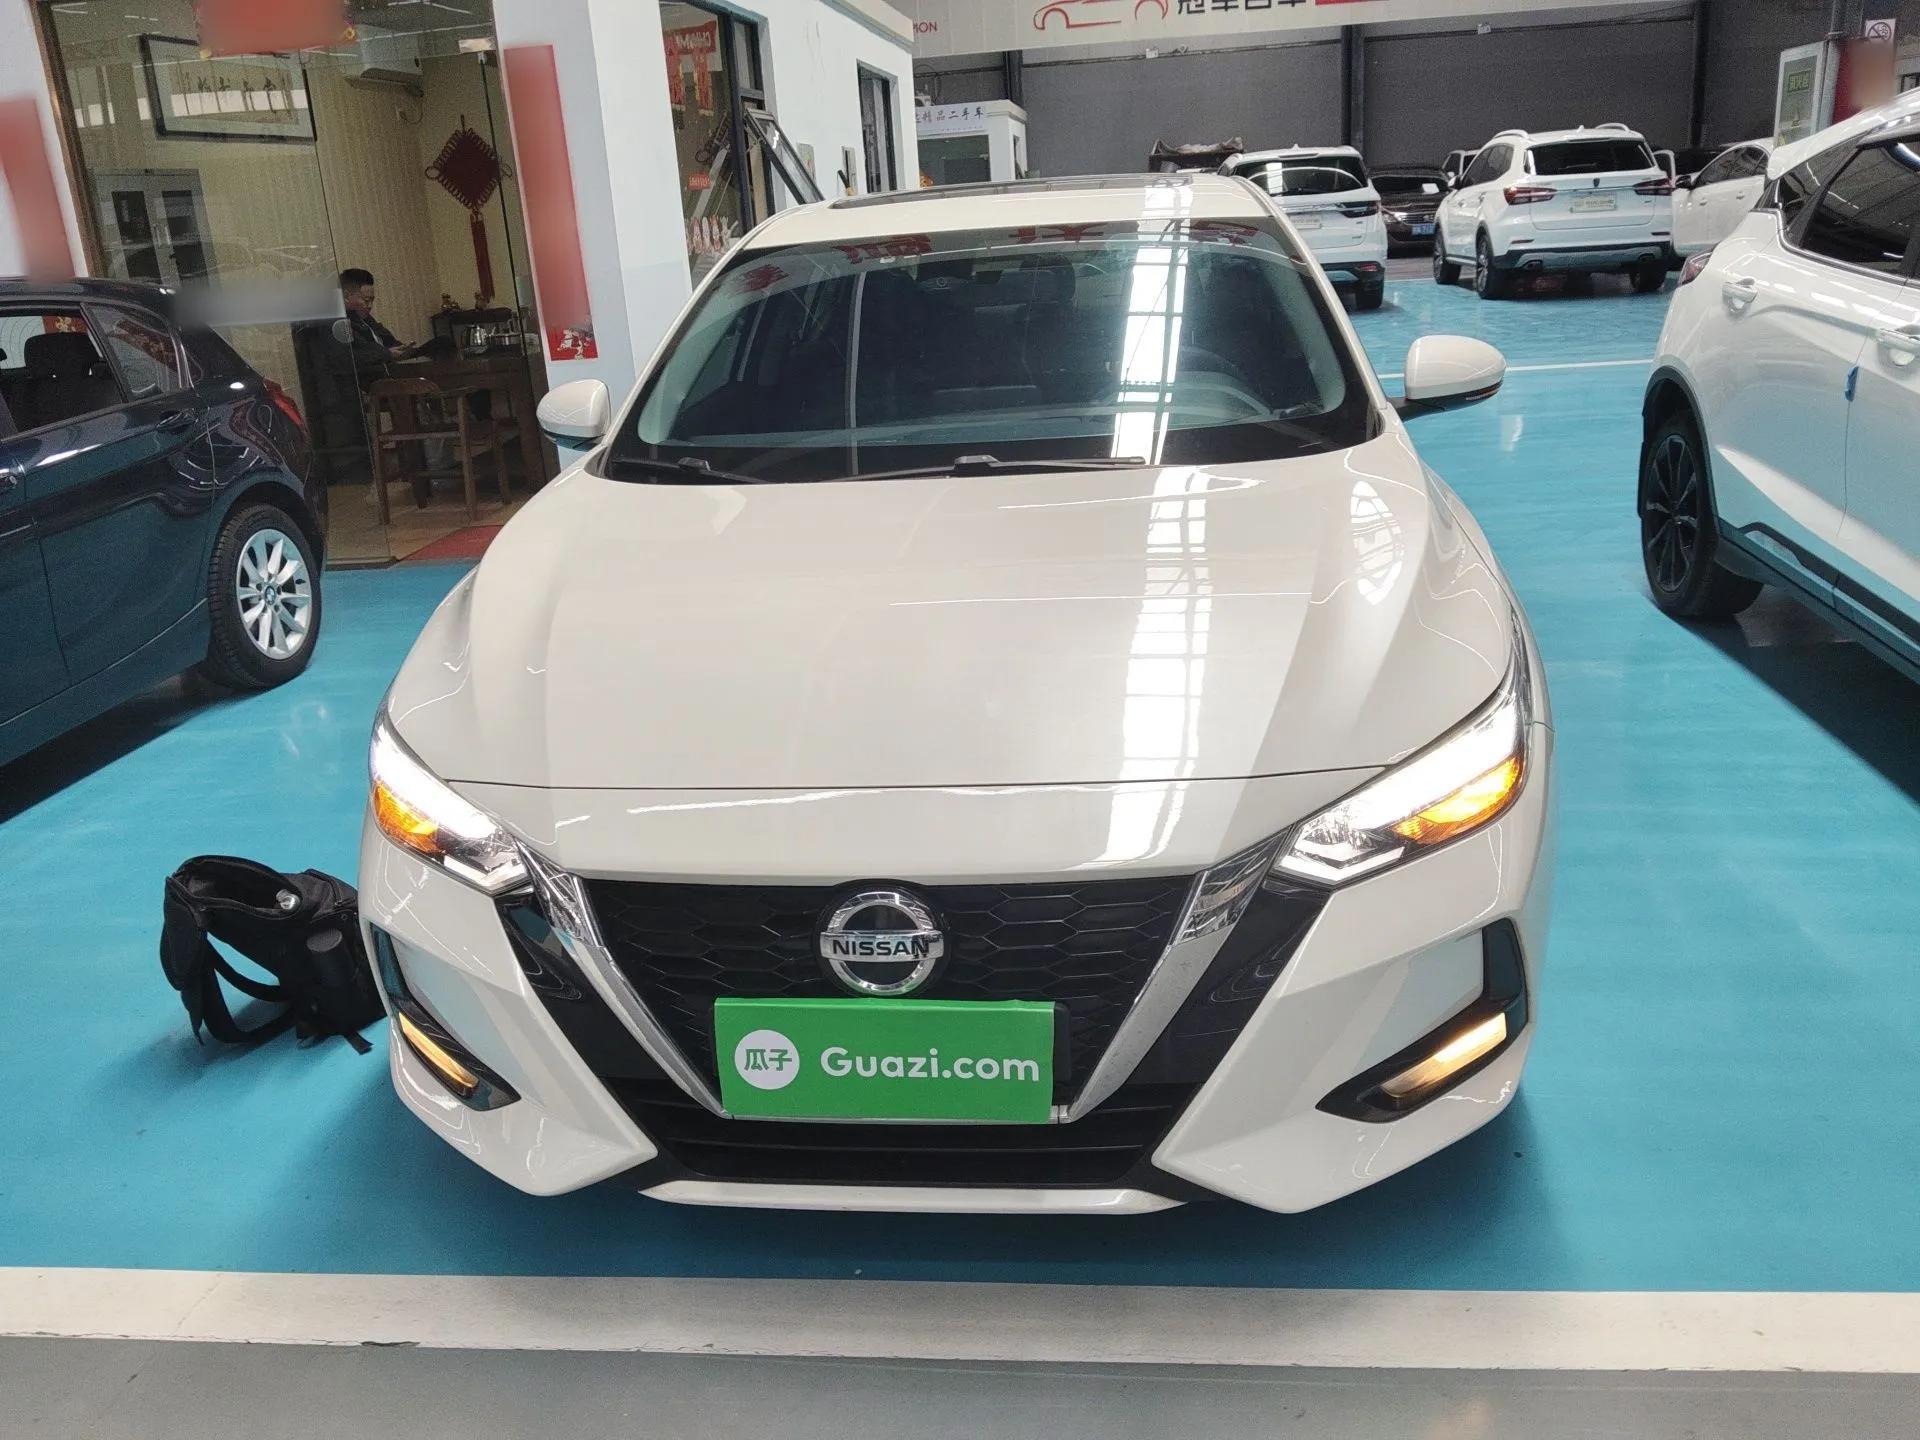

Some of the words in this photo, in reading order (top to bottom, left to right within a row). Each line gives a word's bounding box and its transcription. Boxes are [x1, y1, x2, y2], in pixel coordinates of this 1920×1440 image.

[833, 938, 930, 958] NISSAN
[744, 1048, 793, 1072] 瓜子
[820, 1046, 1040, 1082] Guazi.com
